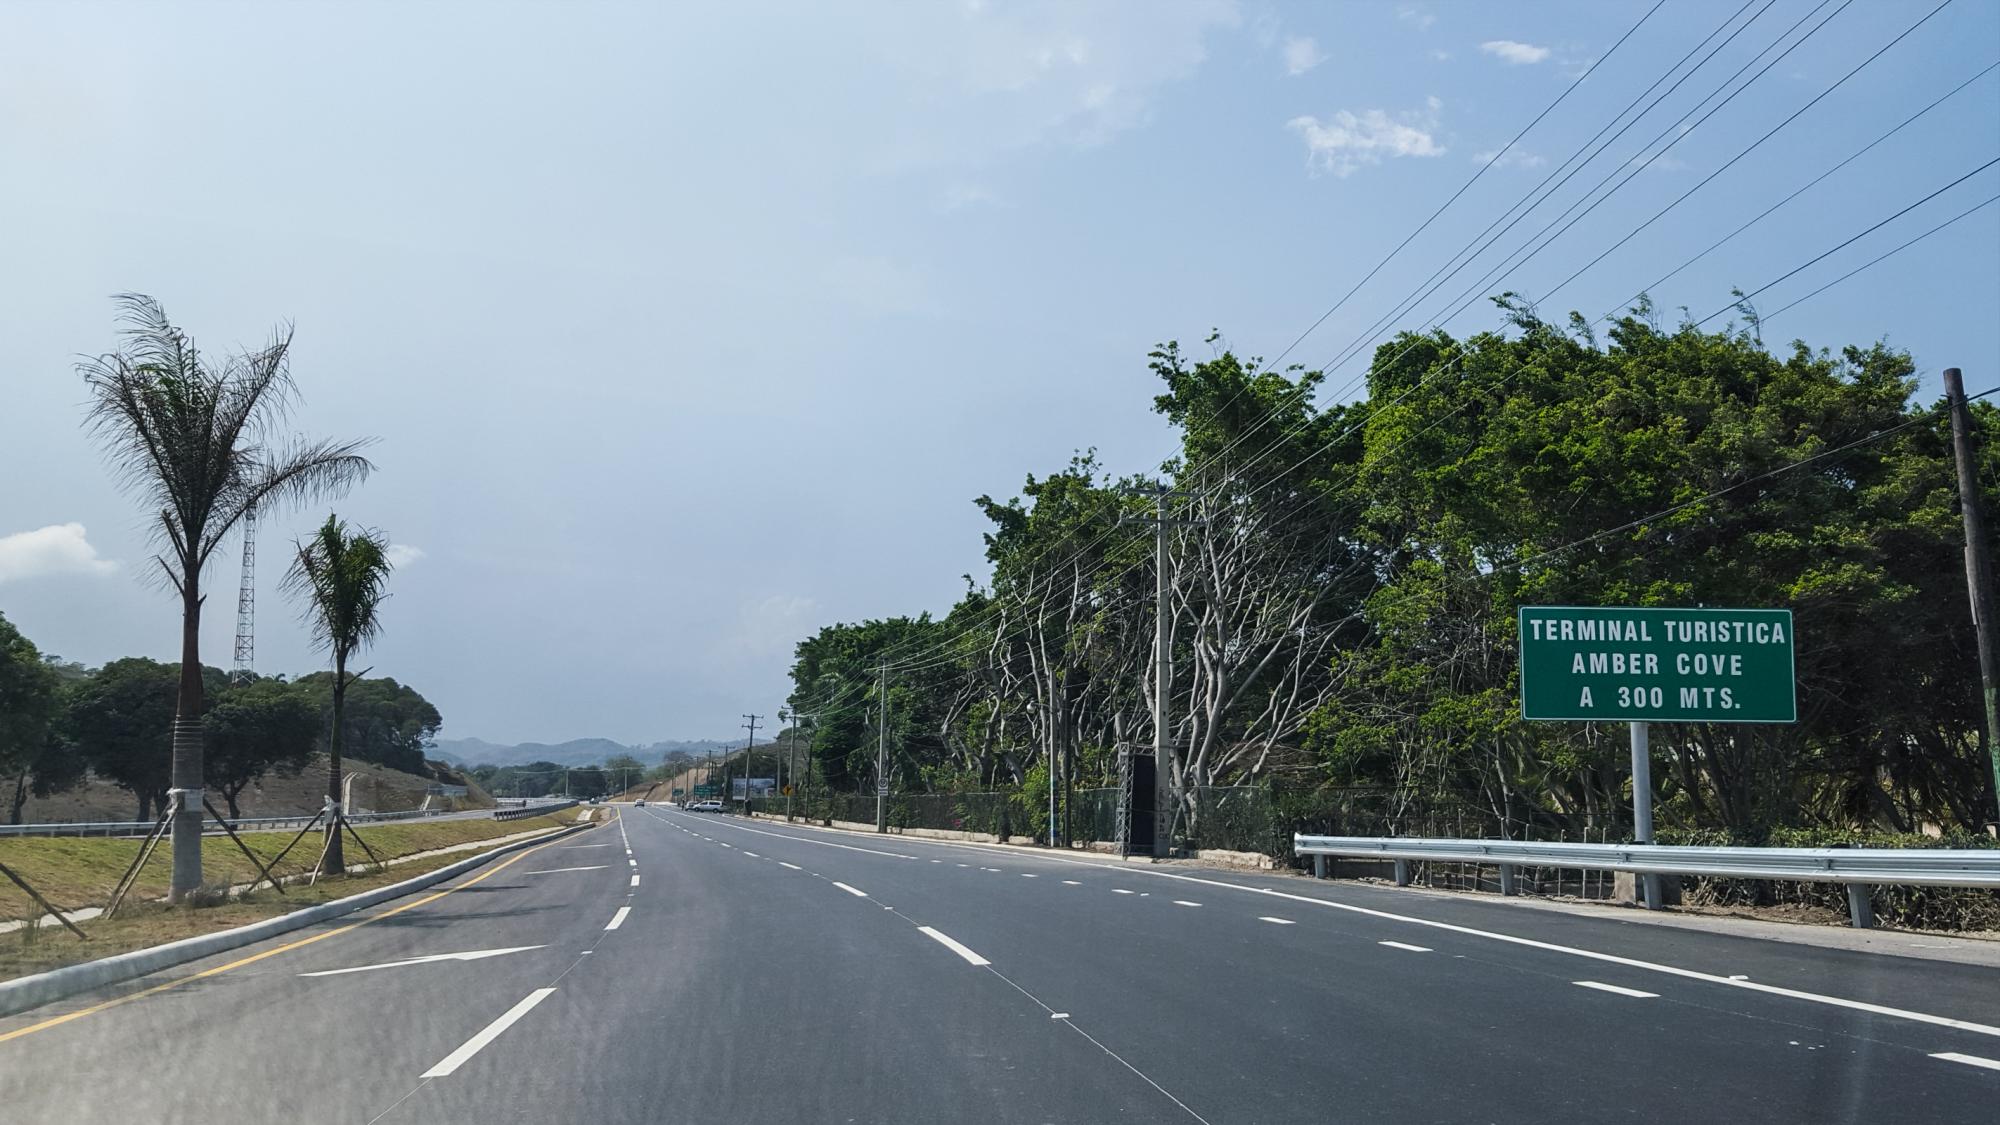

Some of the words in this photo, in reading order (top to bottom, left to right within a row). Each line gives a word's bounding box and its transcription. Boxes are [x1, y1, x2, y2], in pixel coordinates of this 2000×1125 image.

[1530, 619, 1652, 642] TERMINAL
[1664, 621, 1785, 644] TURISTICA
[1572, 653, 1659, 675] AMBER
[1676, 653, 1743, 676] COVE
[1579, 686, 1594, 708] A
[1618, 686, 1663, 709] 300
[1680, 687, 1741, 709] MTS.
